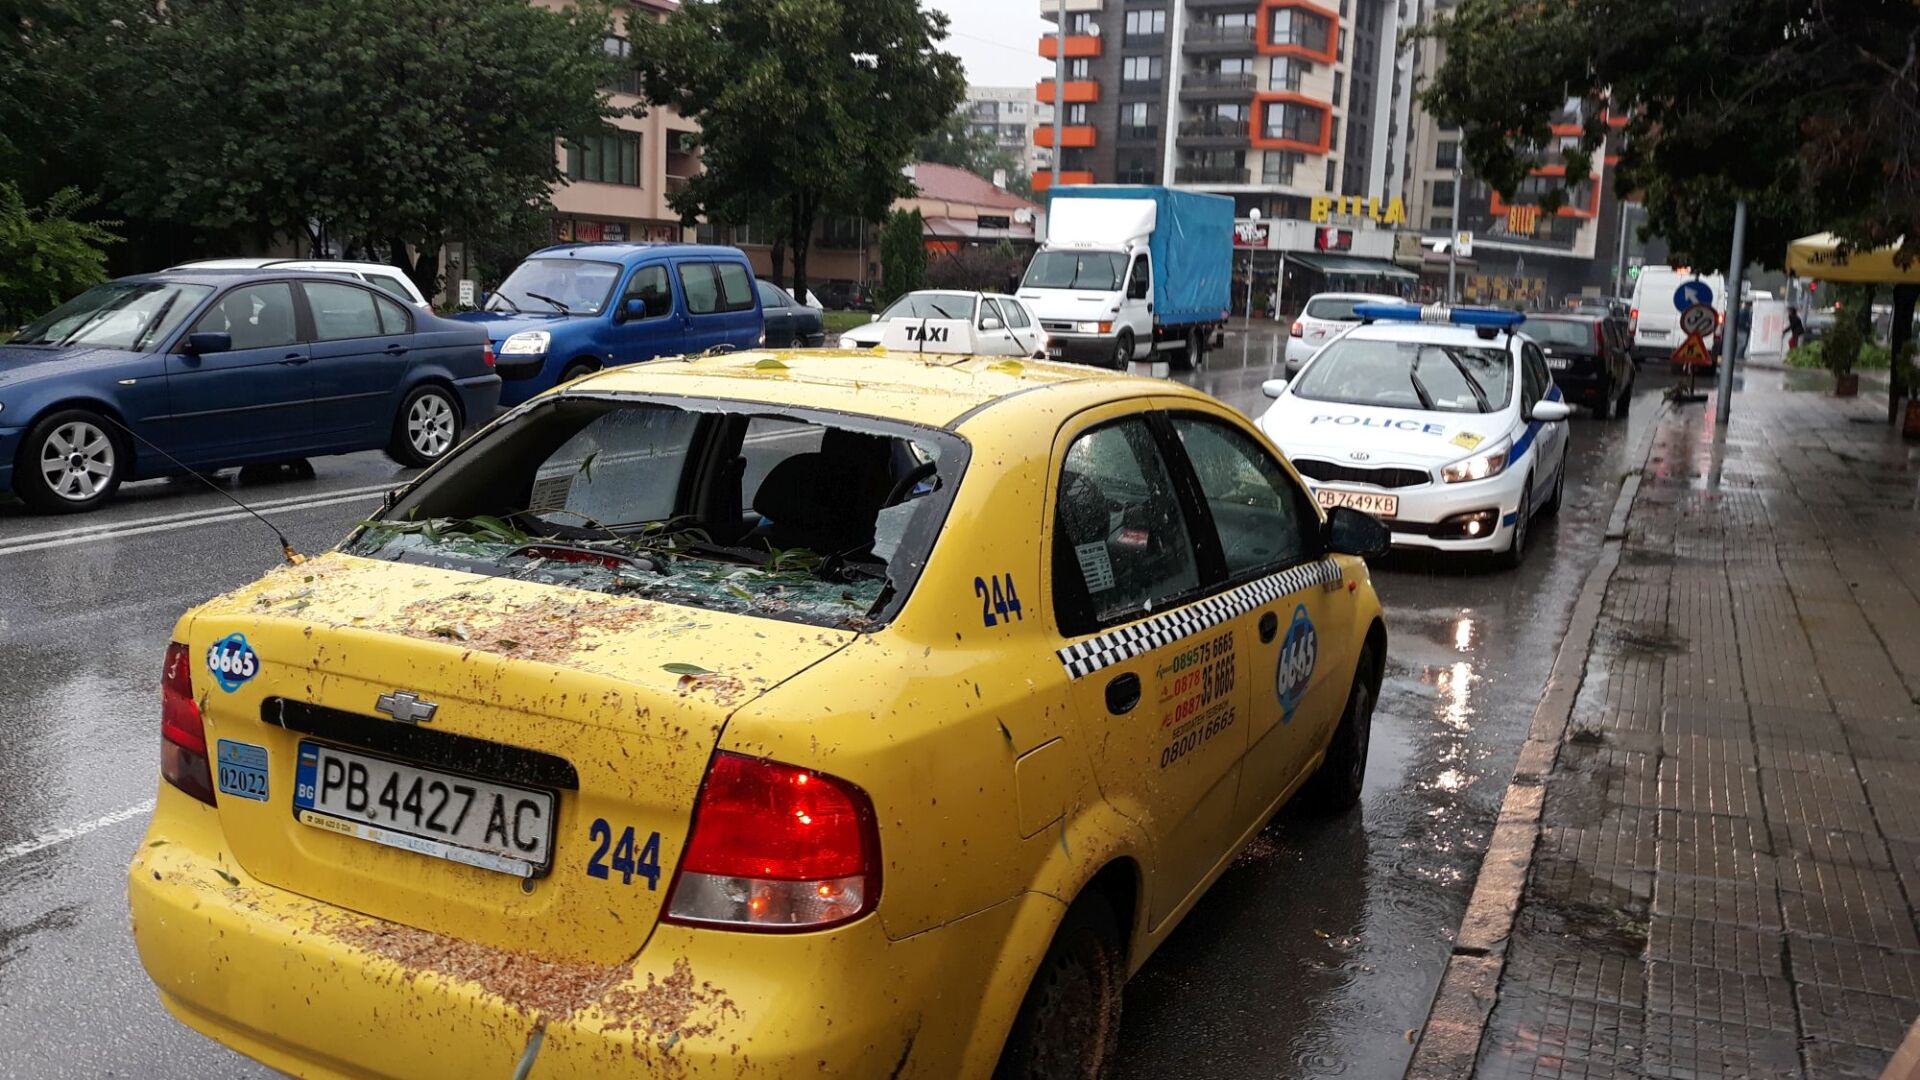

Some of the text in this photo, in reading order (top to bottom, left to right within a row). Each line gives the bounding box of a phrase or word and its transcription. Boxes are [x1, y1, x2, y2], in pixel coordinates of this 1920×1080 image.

[1509, 207, 1536, 235] BILLA
[905, 326, 949, 342] TAXI
[1686, 310, 1713, 331] 30
[1310, 415, 1446, 436] POLICE
[974, 573, 1022, 627] 244
[1212, 631, 1234, 659] 6665
[209, 646, 254, 677] 6665
[1279, 631, 1315, 695] 6665
[1174, 670, 1201, 697] 0878
[1175, 693, 1202, 723] 0887
[220, 766, 266, 796] 02022
[298, 755, 542, 853] BG PB 4427 AC
[587, 817, 661, 891] 244
